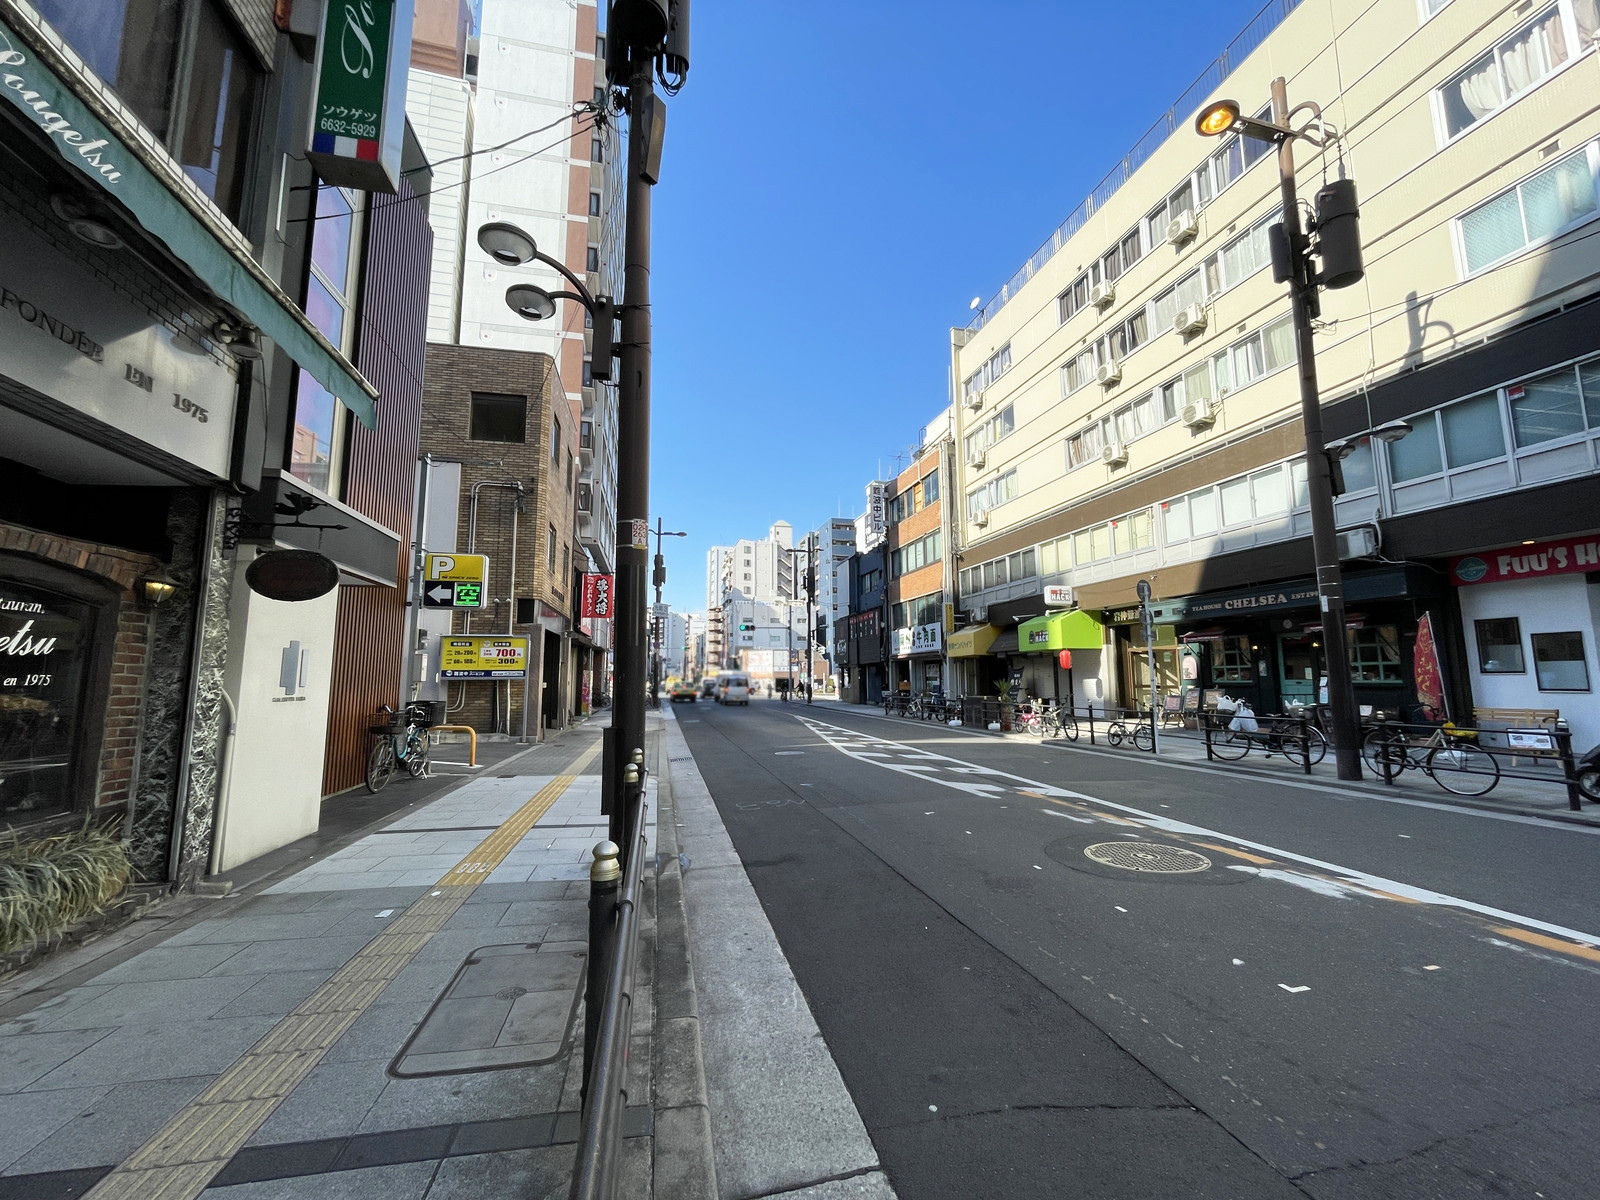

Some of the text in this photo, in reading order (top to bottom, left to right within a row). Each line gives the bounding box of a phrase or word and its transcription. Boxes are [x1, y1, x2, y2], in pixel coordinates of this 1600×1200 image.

[322, 104, 377, 122] ソウゲツ
[320, 117, 376, 137] 6632-5929
[173, 393, 209, 424] 1975
[431, 555, 456, 580] P
[1497, 542, 1600, 575] FUU'S H
[1050, 593, 1071, 602] HACK
[1224, 593, 1288, 610] CHELSEA
[3, 674, 52, 687] en 1975
